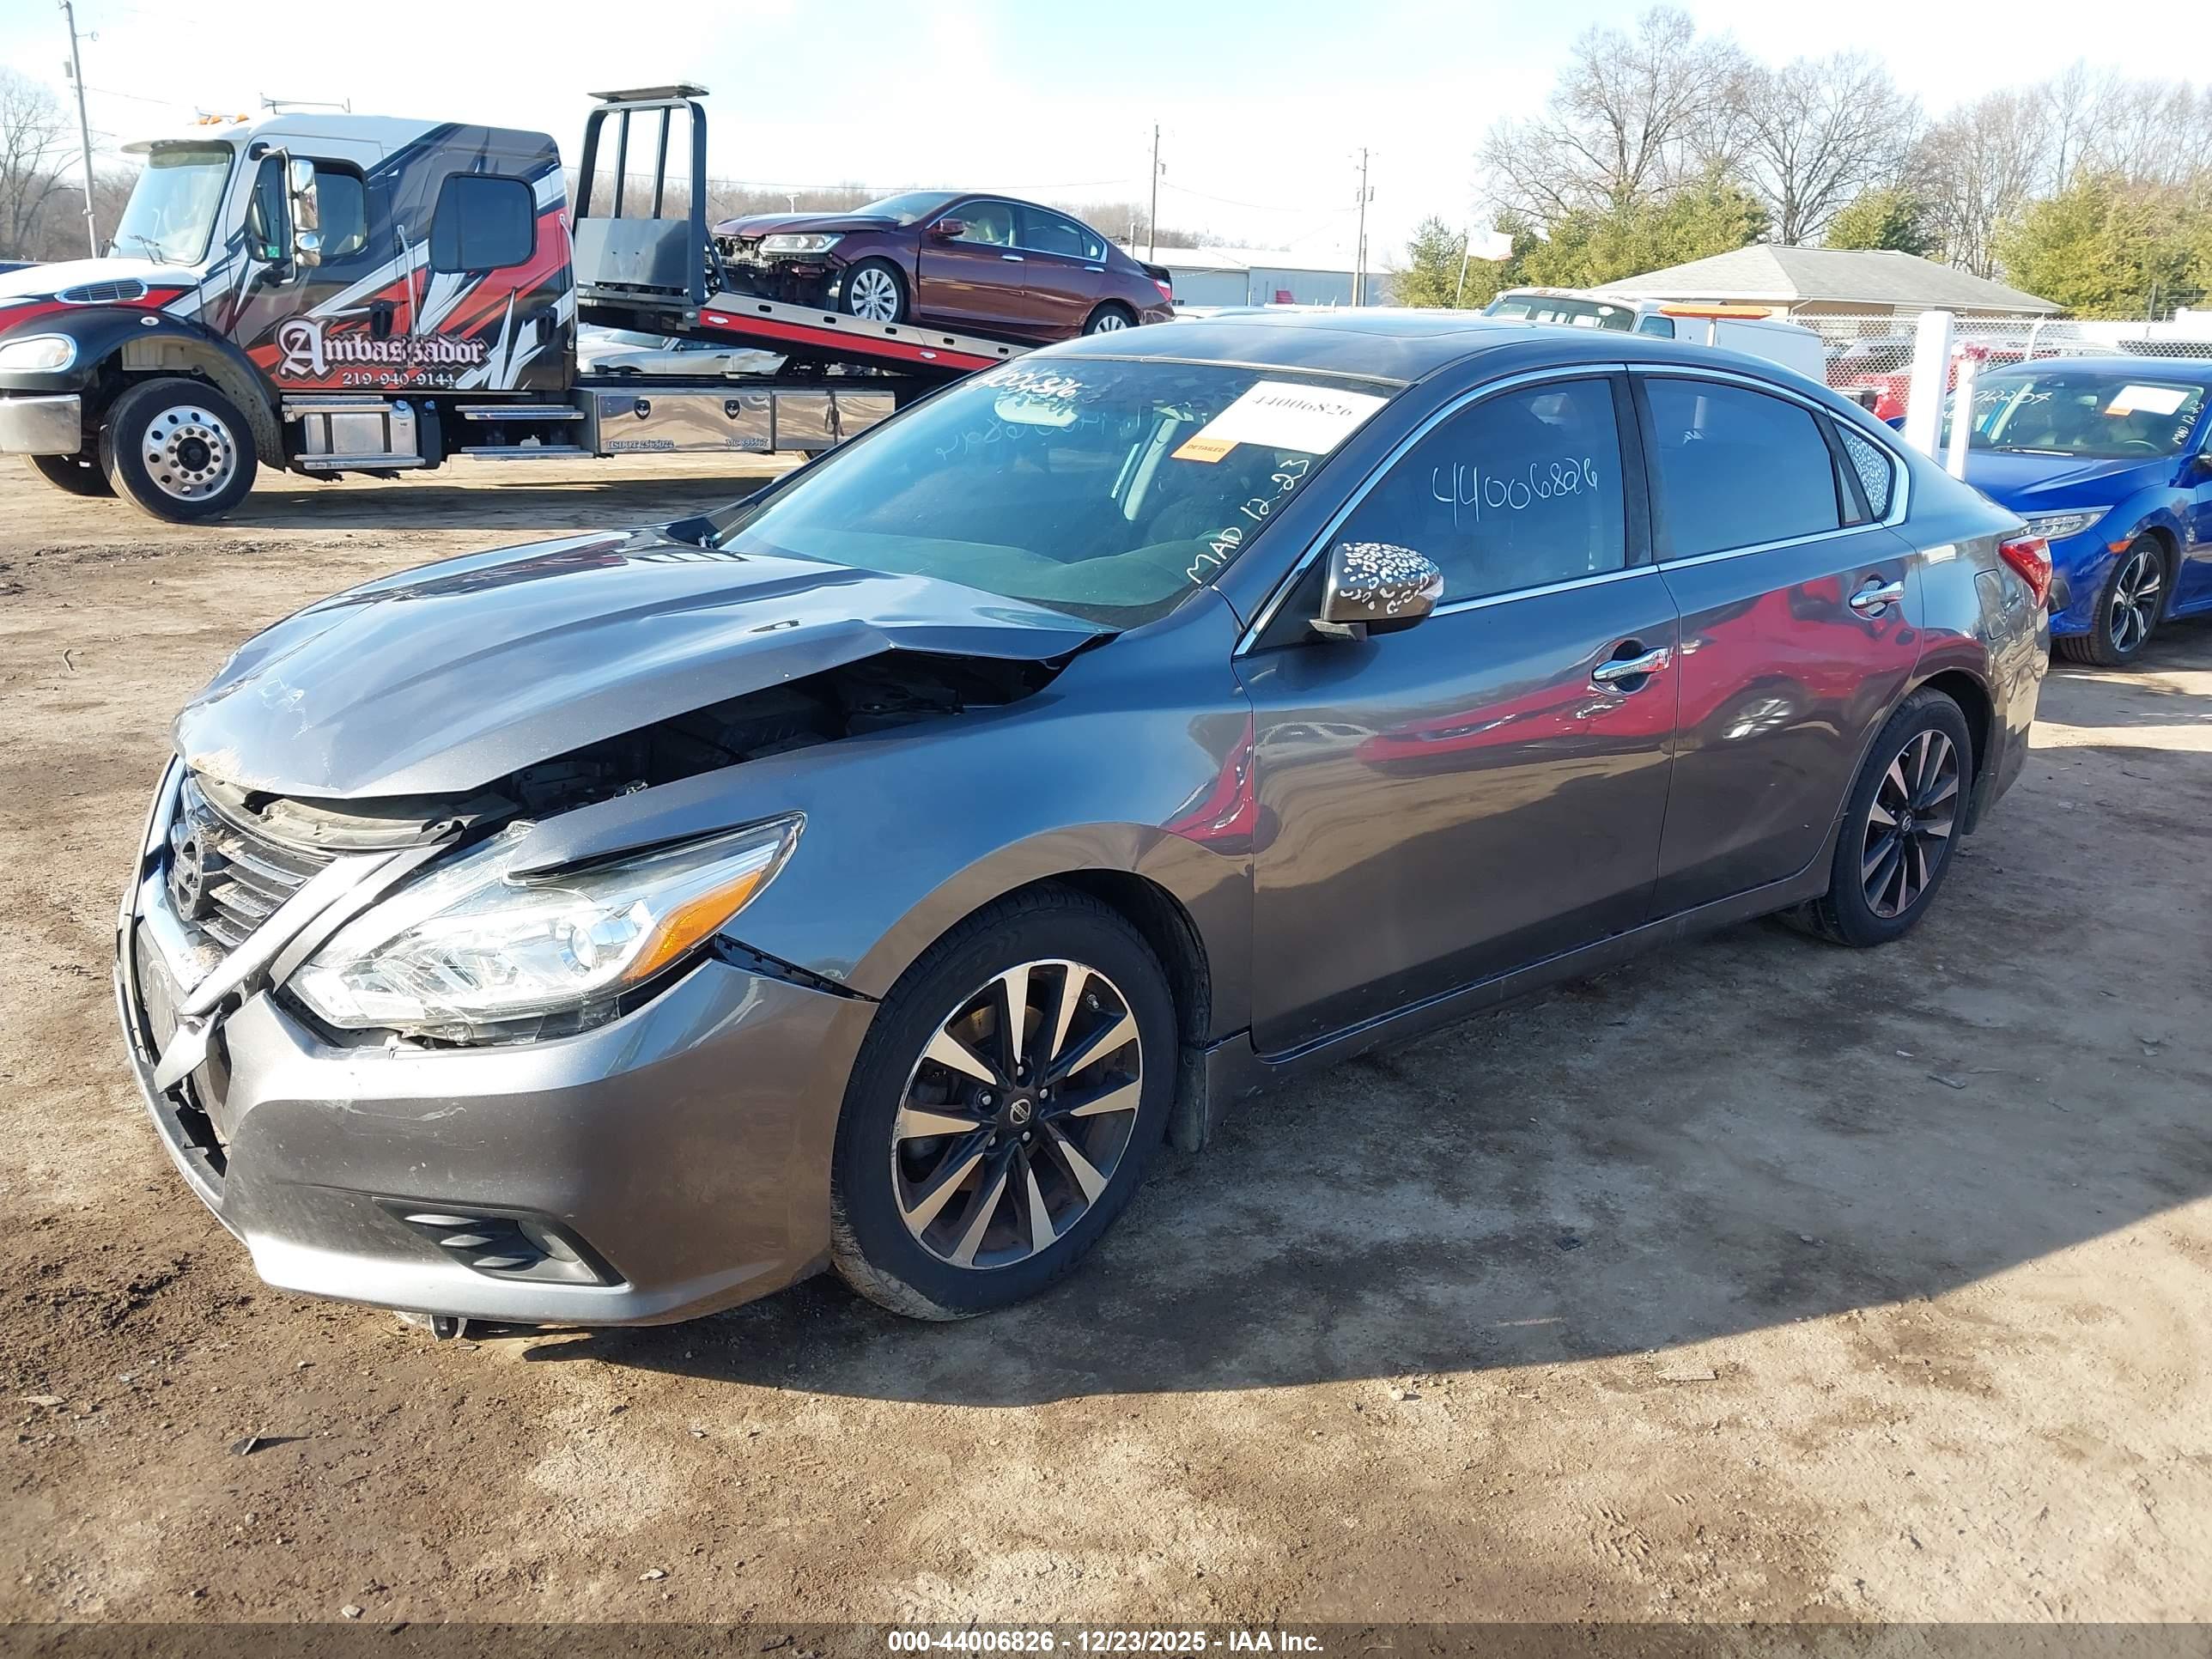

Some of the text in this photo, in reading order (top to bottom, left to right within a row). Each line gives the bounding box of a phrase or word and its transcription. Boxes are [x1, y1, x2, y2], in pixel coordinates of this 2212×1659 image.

[279, 319, 484, 376] Ambassador
[1187, 444, 1225, 453] DETAILED
[1432, 458, 1597, 527] 44006826
[1187, 526, 1243, 584] MAD
